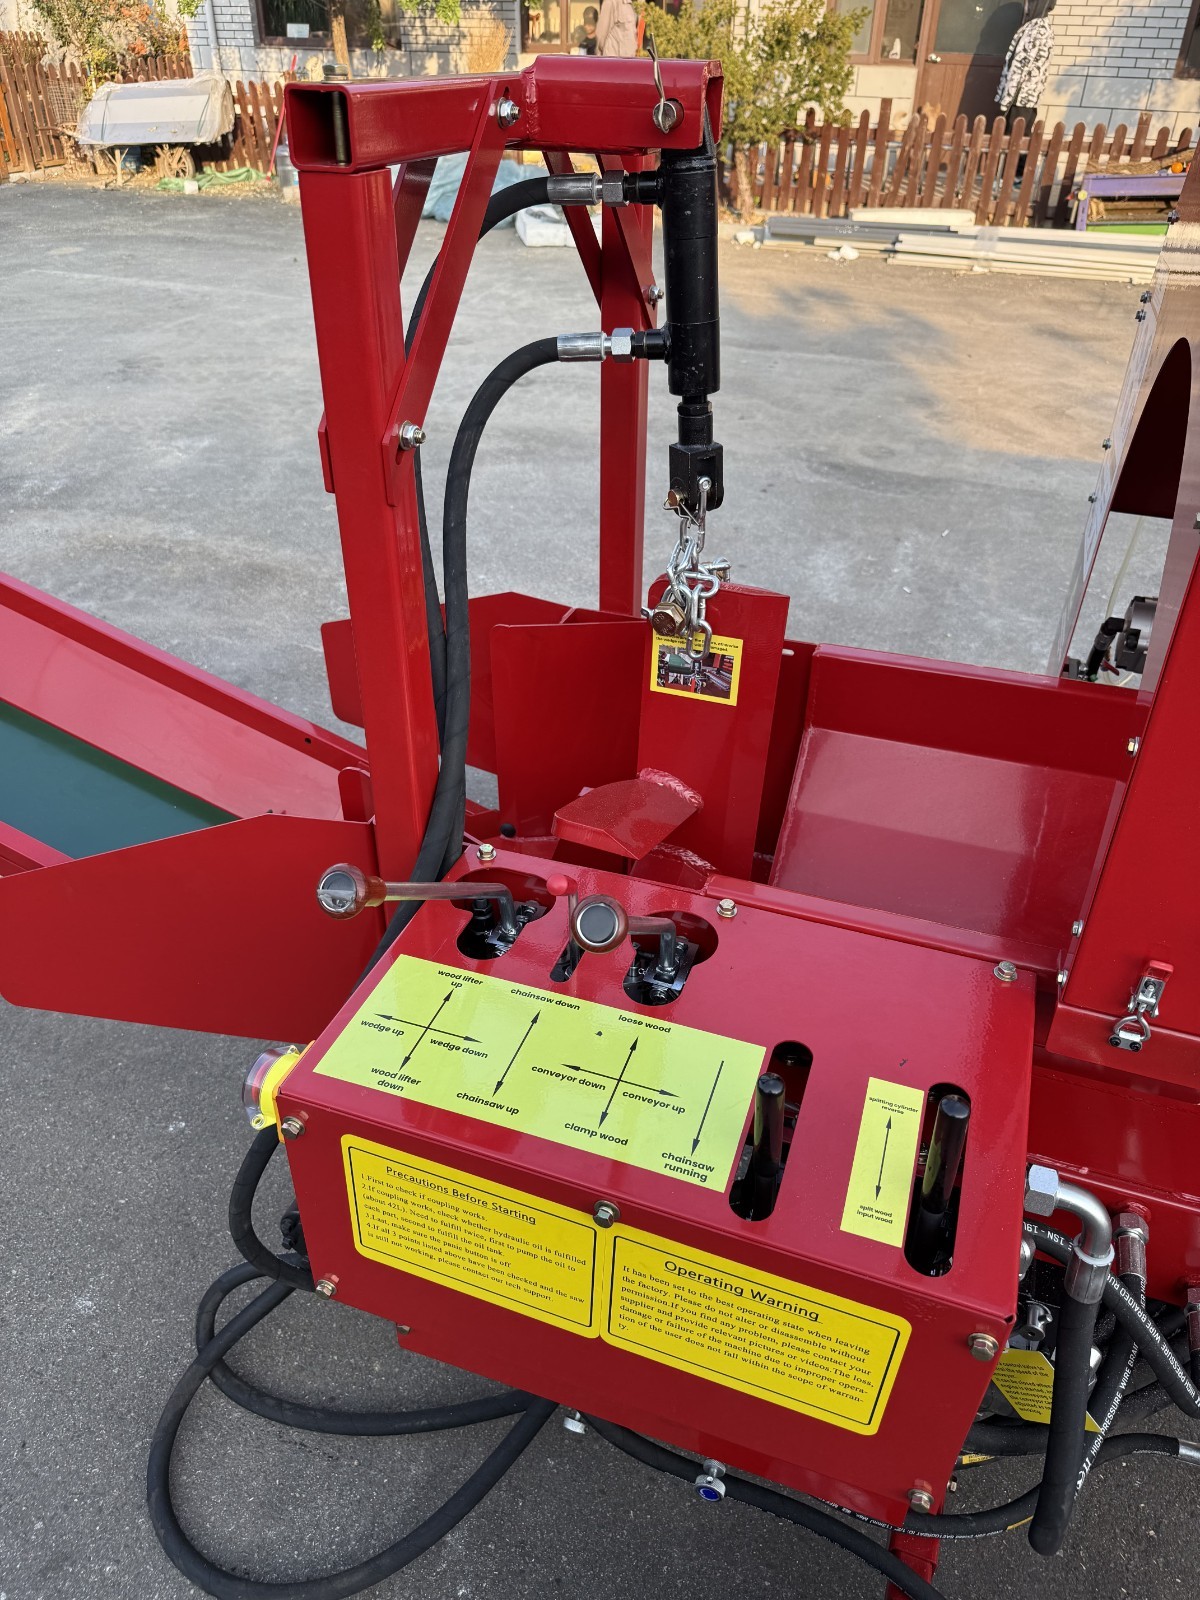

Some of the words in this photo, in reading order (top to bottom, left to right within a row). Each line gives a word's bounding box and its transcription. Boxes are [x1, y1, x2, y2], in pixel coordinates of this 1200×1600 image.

[437, 970, 462, 980] wood
[462, 975, 484, 985] lifter
[450, 981, 463, 989] up
[510, 989, 555, 1004] chainsaw
[554, 1000, 580, 1011] down
[360, 1020, 391, 1032] wedge
[391, 1028, 405, 1037] up
[618, 1014, 644, 1026] loose
[645, 1022, 672, 1033] wood
[430, 1038, 461, 1052] wedge
[461, 1047, 488, 1059] down
[371, 1067, 398, 1079] wood
[397, 1074, 422, 1086] lifter
[377, 1079, 404, 1092] down
[531, 1066, 578, 1083] conveyor
[578, 1078, 606, 1091] down
[456, 1092, 505, 1110] chainsaw
[505, 1106, 520, 1116] up
[622, 1091, 671, 1109] conveyor
[671, 1105, 686, 1115] up
[868, 1096, 894, 1108] splitting
[893, 1103, 919, 1113] cylinder
[881, 1105, 904, 1115] reverse
[564, 1123, 598, 1138] clamp
[599, 1132, 629, 1146] wood
[661, 1152, 715, 1173] chainsaw
[664, 1163, 708, 1183] running
[386, 1166, 449, 1194] Precautions
[452, 1188, 488, 1207] Before
[491, 1202, 536, 1226] Starting
[395, 1186, 418, 1198] check
[419, 1192, 426, 1200] if
[427, 1197, 460, 1213] coupling
[462, 1209, 488, 1222] works.
[856, 1209, 874, 1219] input
[874, 1215, 893, 1224] wood
[859, 1205, 874, 1213] split
[874, 1209, 893, 1218] wood
[376, 1189, 409, 1205] coupling
[410, 1201, 436, 1214] works,
[437, 1210, 459, 1222] check
[461, 1218, 492, 1233] whether
[493, 1228, 530, 1246] hydraulic
[532, 1243, 543, 1251] oil
[554, 1250, 586, 1266] fulfilled
[409, 1208, 429, 1221] Need
[440, 1220, 462, 1232] fulfill
[489, 1236, 505, 1247] first
[516, 1247, 539, 1260] pump
[540, 1255, 553, 1264] the
[429, 1235, 441, 1244] the
[464, 1247, 489, 1261] button
[437, 1228, 459, 1241] fulfill
[460, 1237, 473, 1245] the
[474, 1242, 485, 1250] oil
[486, 1246, 504, 1257] tank.
[398, 1234, 421, 1246] points
[444, 1250, 466, 1262] above
[487, 1264, 505, 1276] been
[506, 1272, 538, 1287] checked
[539, 1284, 554, 1293] and
[555, 1289, 568, 1298] the
[404, 1245, 436, 1261] working,
[505, 1280, 521, 1290] tech
[664, 1260, 744, 1298] Operating
[750, 1288, 819, 1323] Warning
[623, 1265, 630, 1273] It
[632, 1268, 647, 1279] has
[649, 1274, 670, 1287] been
[672, 1284, 685, 1292] set
[687, 1288, 697, 1296] to
[699, 1292, 713, 1301] the
[715, 1297, 734, 1309] best
[736, 1306, 780, 1325] operating
[782, 1321, 805, 1332] state
[807, 1329, 832, 1342] when
[835, 1337, 870, 1356] leaving
[1119, 1287, 1147, 1322] BRAIDED
[621, 1286, 679, 1310] permission.If
[680, 1306, 697, 1316] you
[699, 1312, 718, 1323] find
[719, 1320, 736, 1330] any
[738, 1327, 779, 1345] problem,
[781, 1341, 810, 1355] please
[812, 1352, 847, 1368] contact
[848, 1364, 871, 1376] your
[622, 1276, 635, 1285] the
[638, 1280, 670, 1297] factory.
[674, 1293, 702, 1308] Please
[704, 1304, 716, 1312] do
[718, 1309, 733, 1319] not
[735, 1316, 757, 1326] alter
[770, 1327, 827, 1350] disassemble
[829, 1347, 866, 1364] without
[1145, 1319, 1161, 1343] WIRE
[619, 1304, 652, 1320] damage
[666, 1320, 694, 1335] failure
[708, 1335, 722, 1344] the
[724, 1341, 762, 1358] machine
[764, 1355, 781, 1365] due
[794, 1364, 837, 1384] improper
[838, 1381, 868, 1394] opera-
[619, 1313, 635, 1324] tion
[649, 1324, 662, 1333] the
[664, 1330, 683, 1340] user
[684, 1337, 705, 1348] does
[707, 1345, 721, 1354] not
[723, 1350, 738, 1360] fall
[741, 1357, 769, 1370] within
[771, 1367, 786, 1376] the
[787, 1373, 814, 1386] scope
[620, 1295, 654, 1311] supplier
[657, 1308, 673, 1318] and
[674, 1314, 708, 1330] provide
[710, 1327, 746, 1343] relevant
[748, 1340, 785, 1356] pictures
[853, 1374, 874, 1388] loss,
[1161, 1342, 1186, 1382] PRESSURE
[1090, 1434, 1103, 1456] HIGH
[1098, 1391, 1122, 1435] PRESSURE
[1119, 1367, 1131, 1389] WIRE
